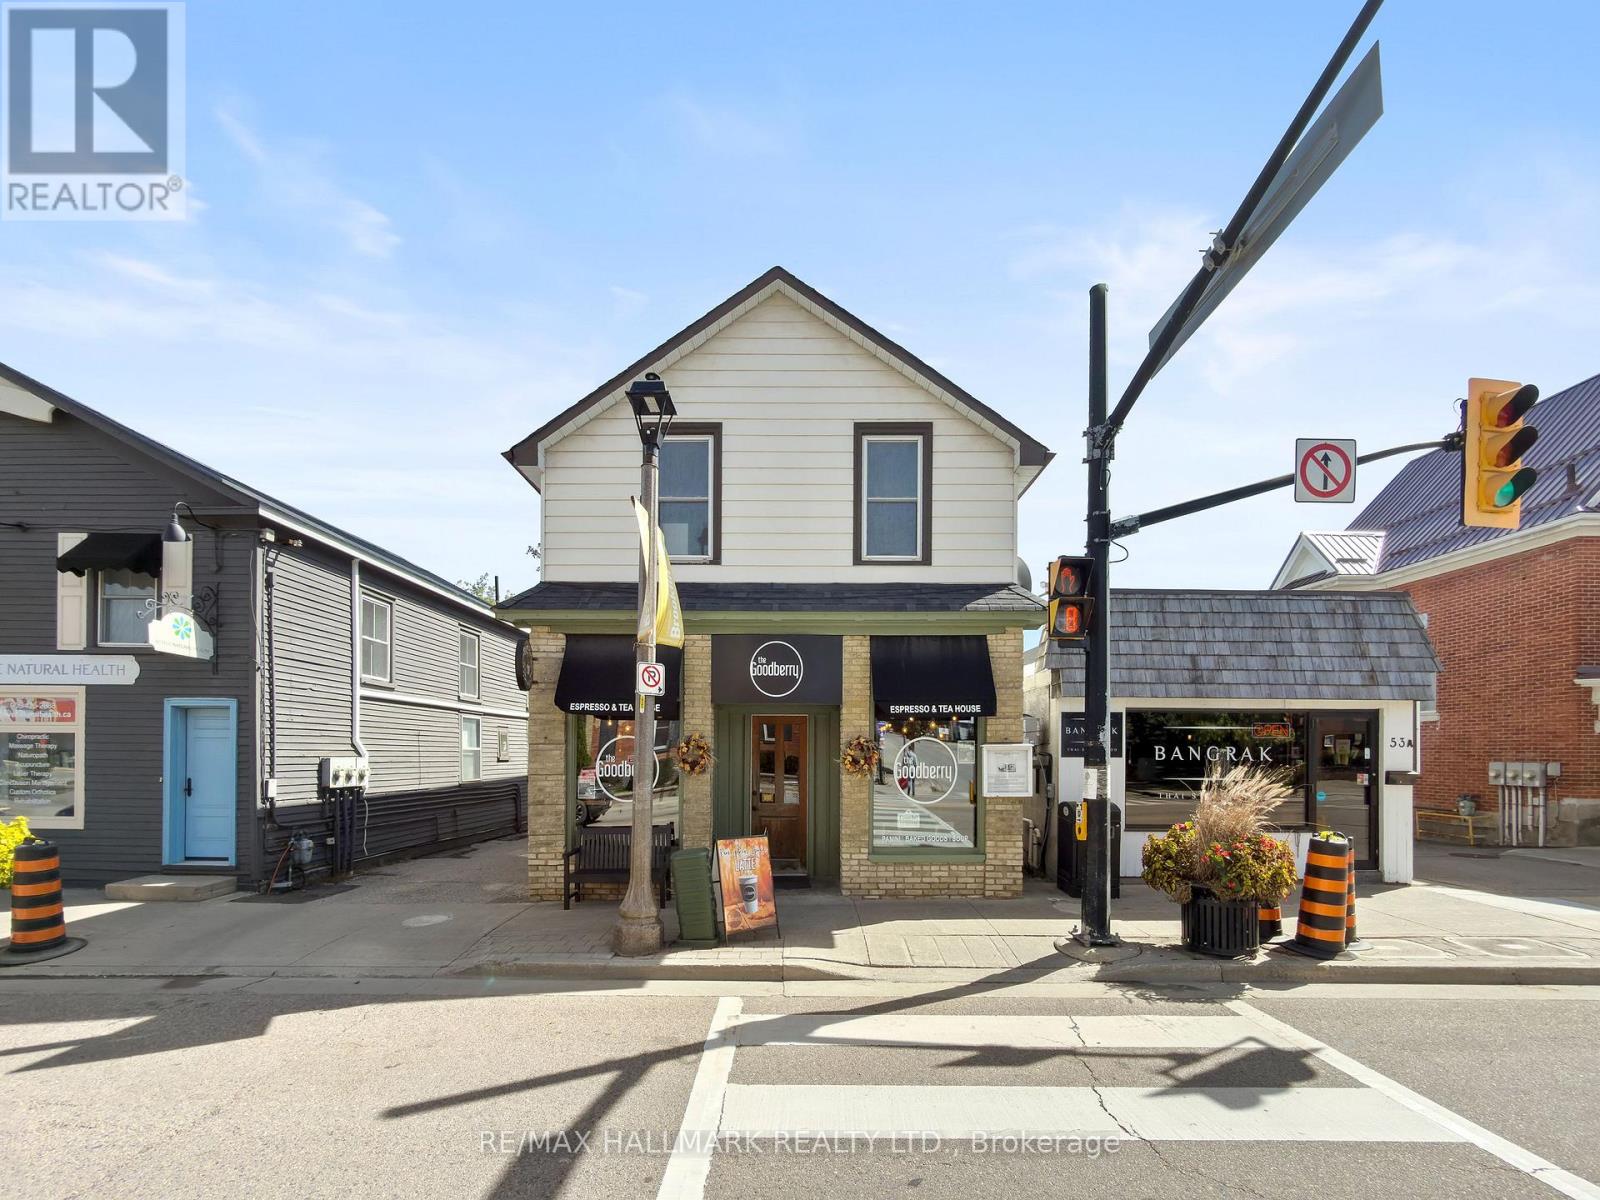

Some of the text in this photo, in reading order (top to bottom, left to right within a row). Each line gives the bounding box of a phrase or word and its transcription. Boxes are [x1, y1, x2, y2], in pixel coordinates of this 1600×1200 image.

[757, 656, 767, 664] the
[7, 663, 68, 676] NATURAL
[72, 663, 126, 676] HEALTH
[751, 661, 799, 679] Goodberry
[569, 702, 634, 712] ESPRESSO & TEA
[889, 704, 982, 714] ESPRESSO & TEA HOUSE
[1065, 727, 1119, 735] BANK
[1253, 724, 1289, 737] OPEN
[1389, 737, 1414, 748] 53A
[605, 754, 616, 762] the
[1153, 745, 1273, 762] BANGRAK
[597, 760, 634, 778] Goodb
[895, 762, 953, 783] Goodberry
[1159, 792, 1185, 800] THAI
